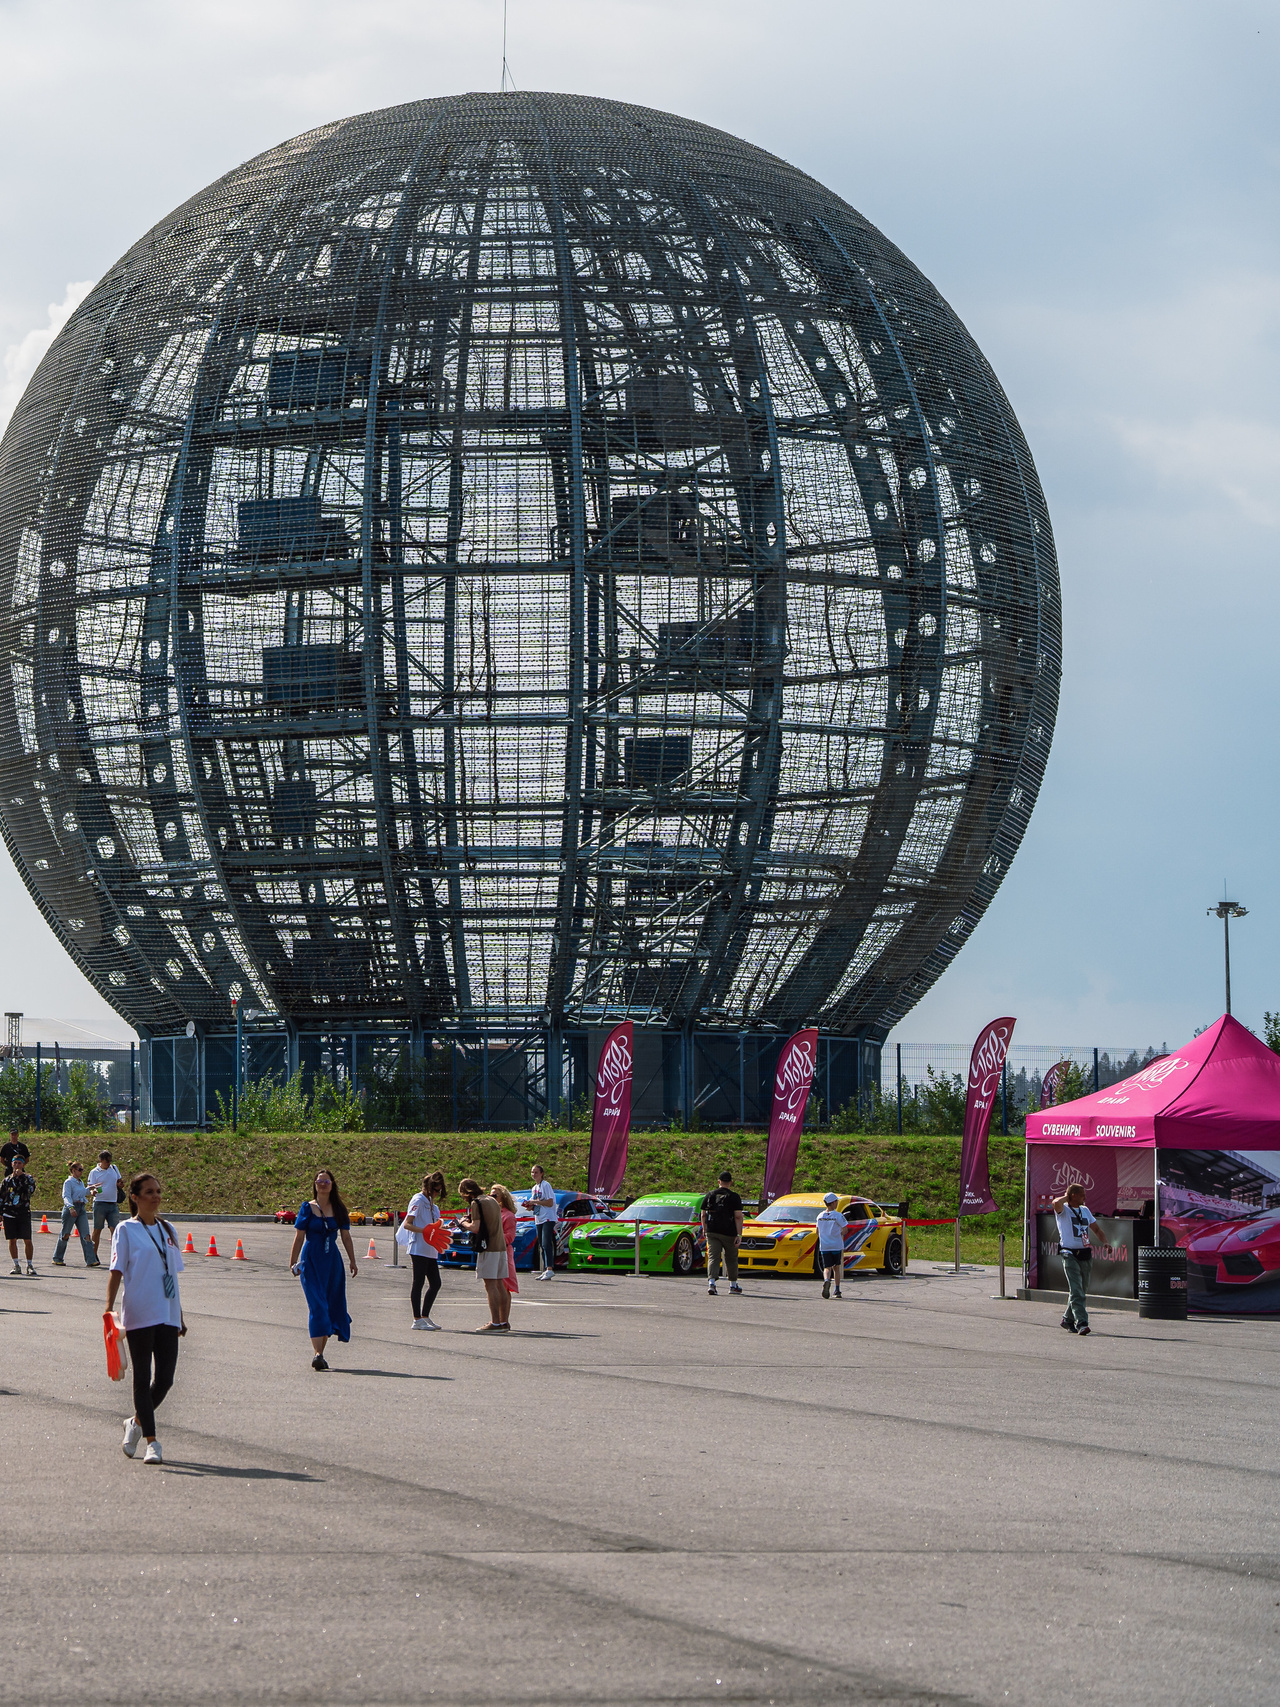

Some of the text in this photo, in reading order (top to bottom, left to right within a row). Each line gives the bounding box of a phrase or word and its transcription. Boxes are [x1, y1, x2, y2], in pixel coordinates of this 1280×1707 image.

[1042, 1123, 1082, 1136] СУВЕНИРЫ
[1096, 1125, 1136, 1138] SOUVENIRS
[665, 1199, 692, 1207] DRIVE
[1138, 1280, 1150, 1289] AFE
